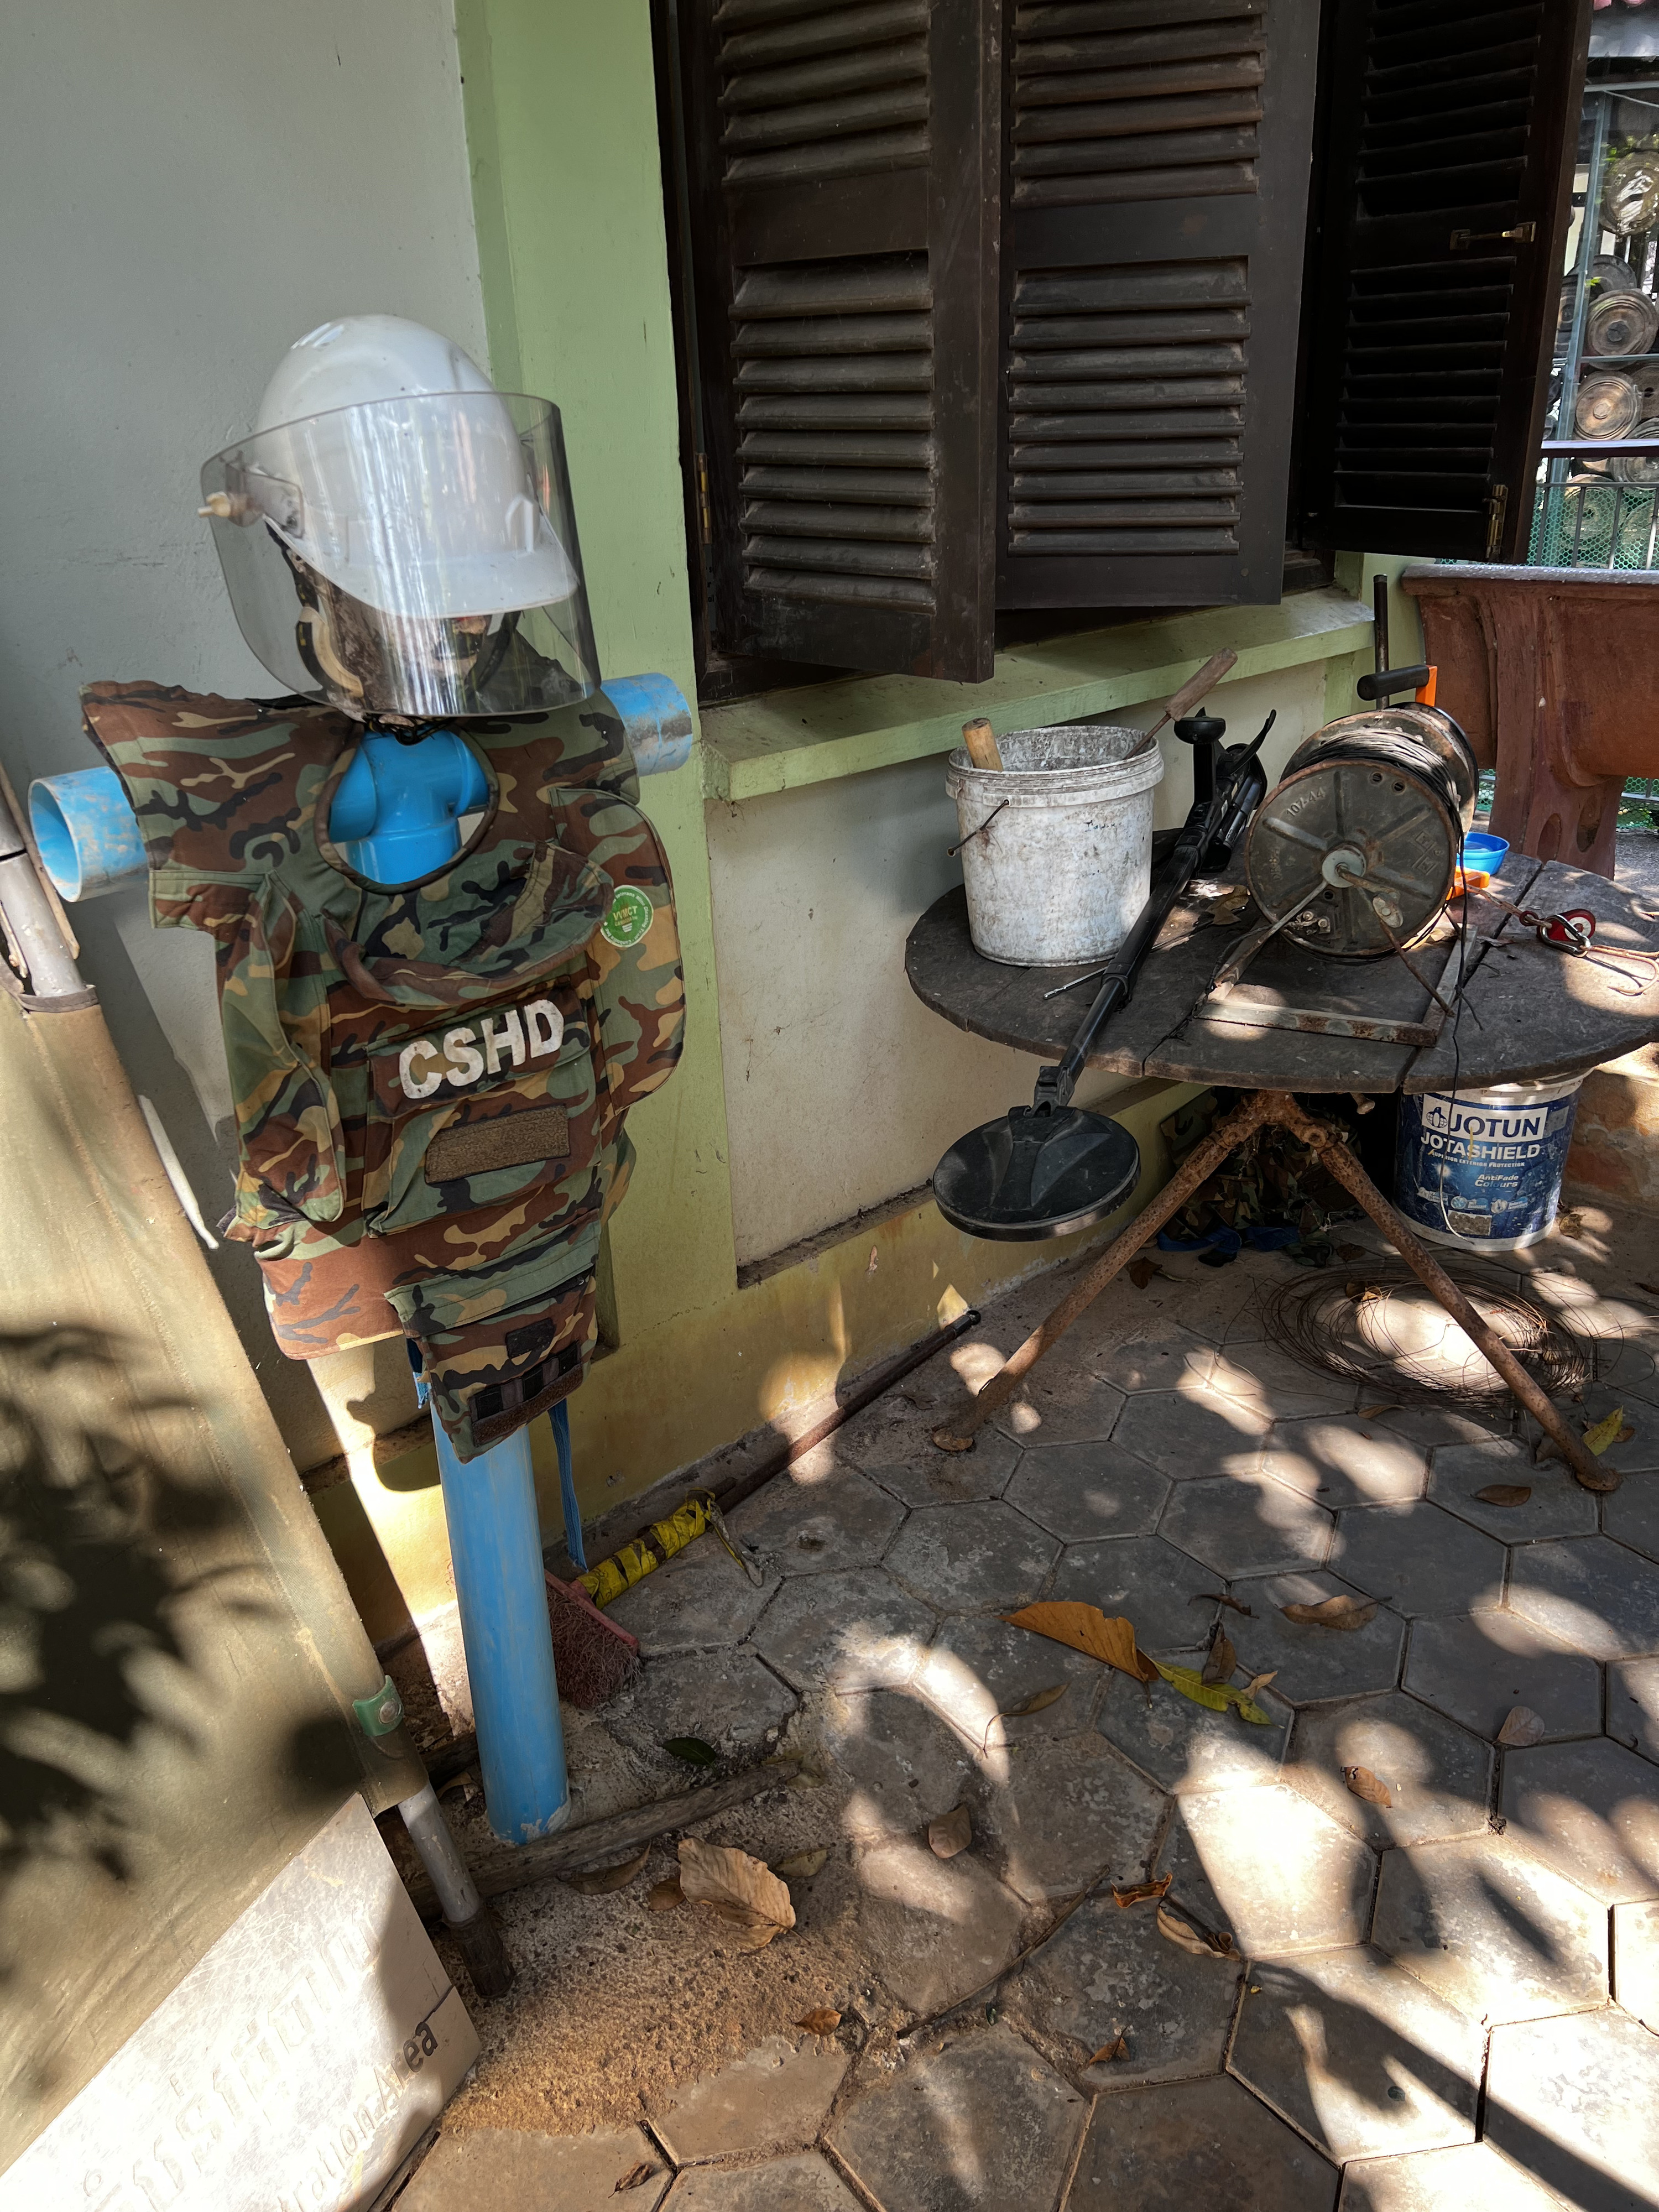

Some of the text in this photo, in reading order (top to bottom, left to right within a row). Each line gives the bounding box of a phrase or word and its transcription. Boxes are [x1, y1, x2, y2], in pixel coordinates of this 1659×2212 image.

[398, 999, 565, 1099] CSHD
[1450, 1113, 1541, 1138] JOTUN
[1421, 1132, 1541, 1160] JOTASHIELD
[1459, 1159, 1488, 1167] EXTERIOR
[1475, 1180, 1519, 1188] Colours
[373, 2022, 438, 2114] Area
